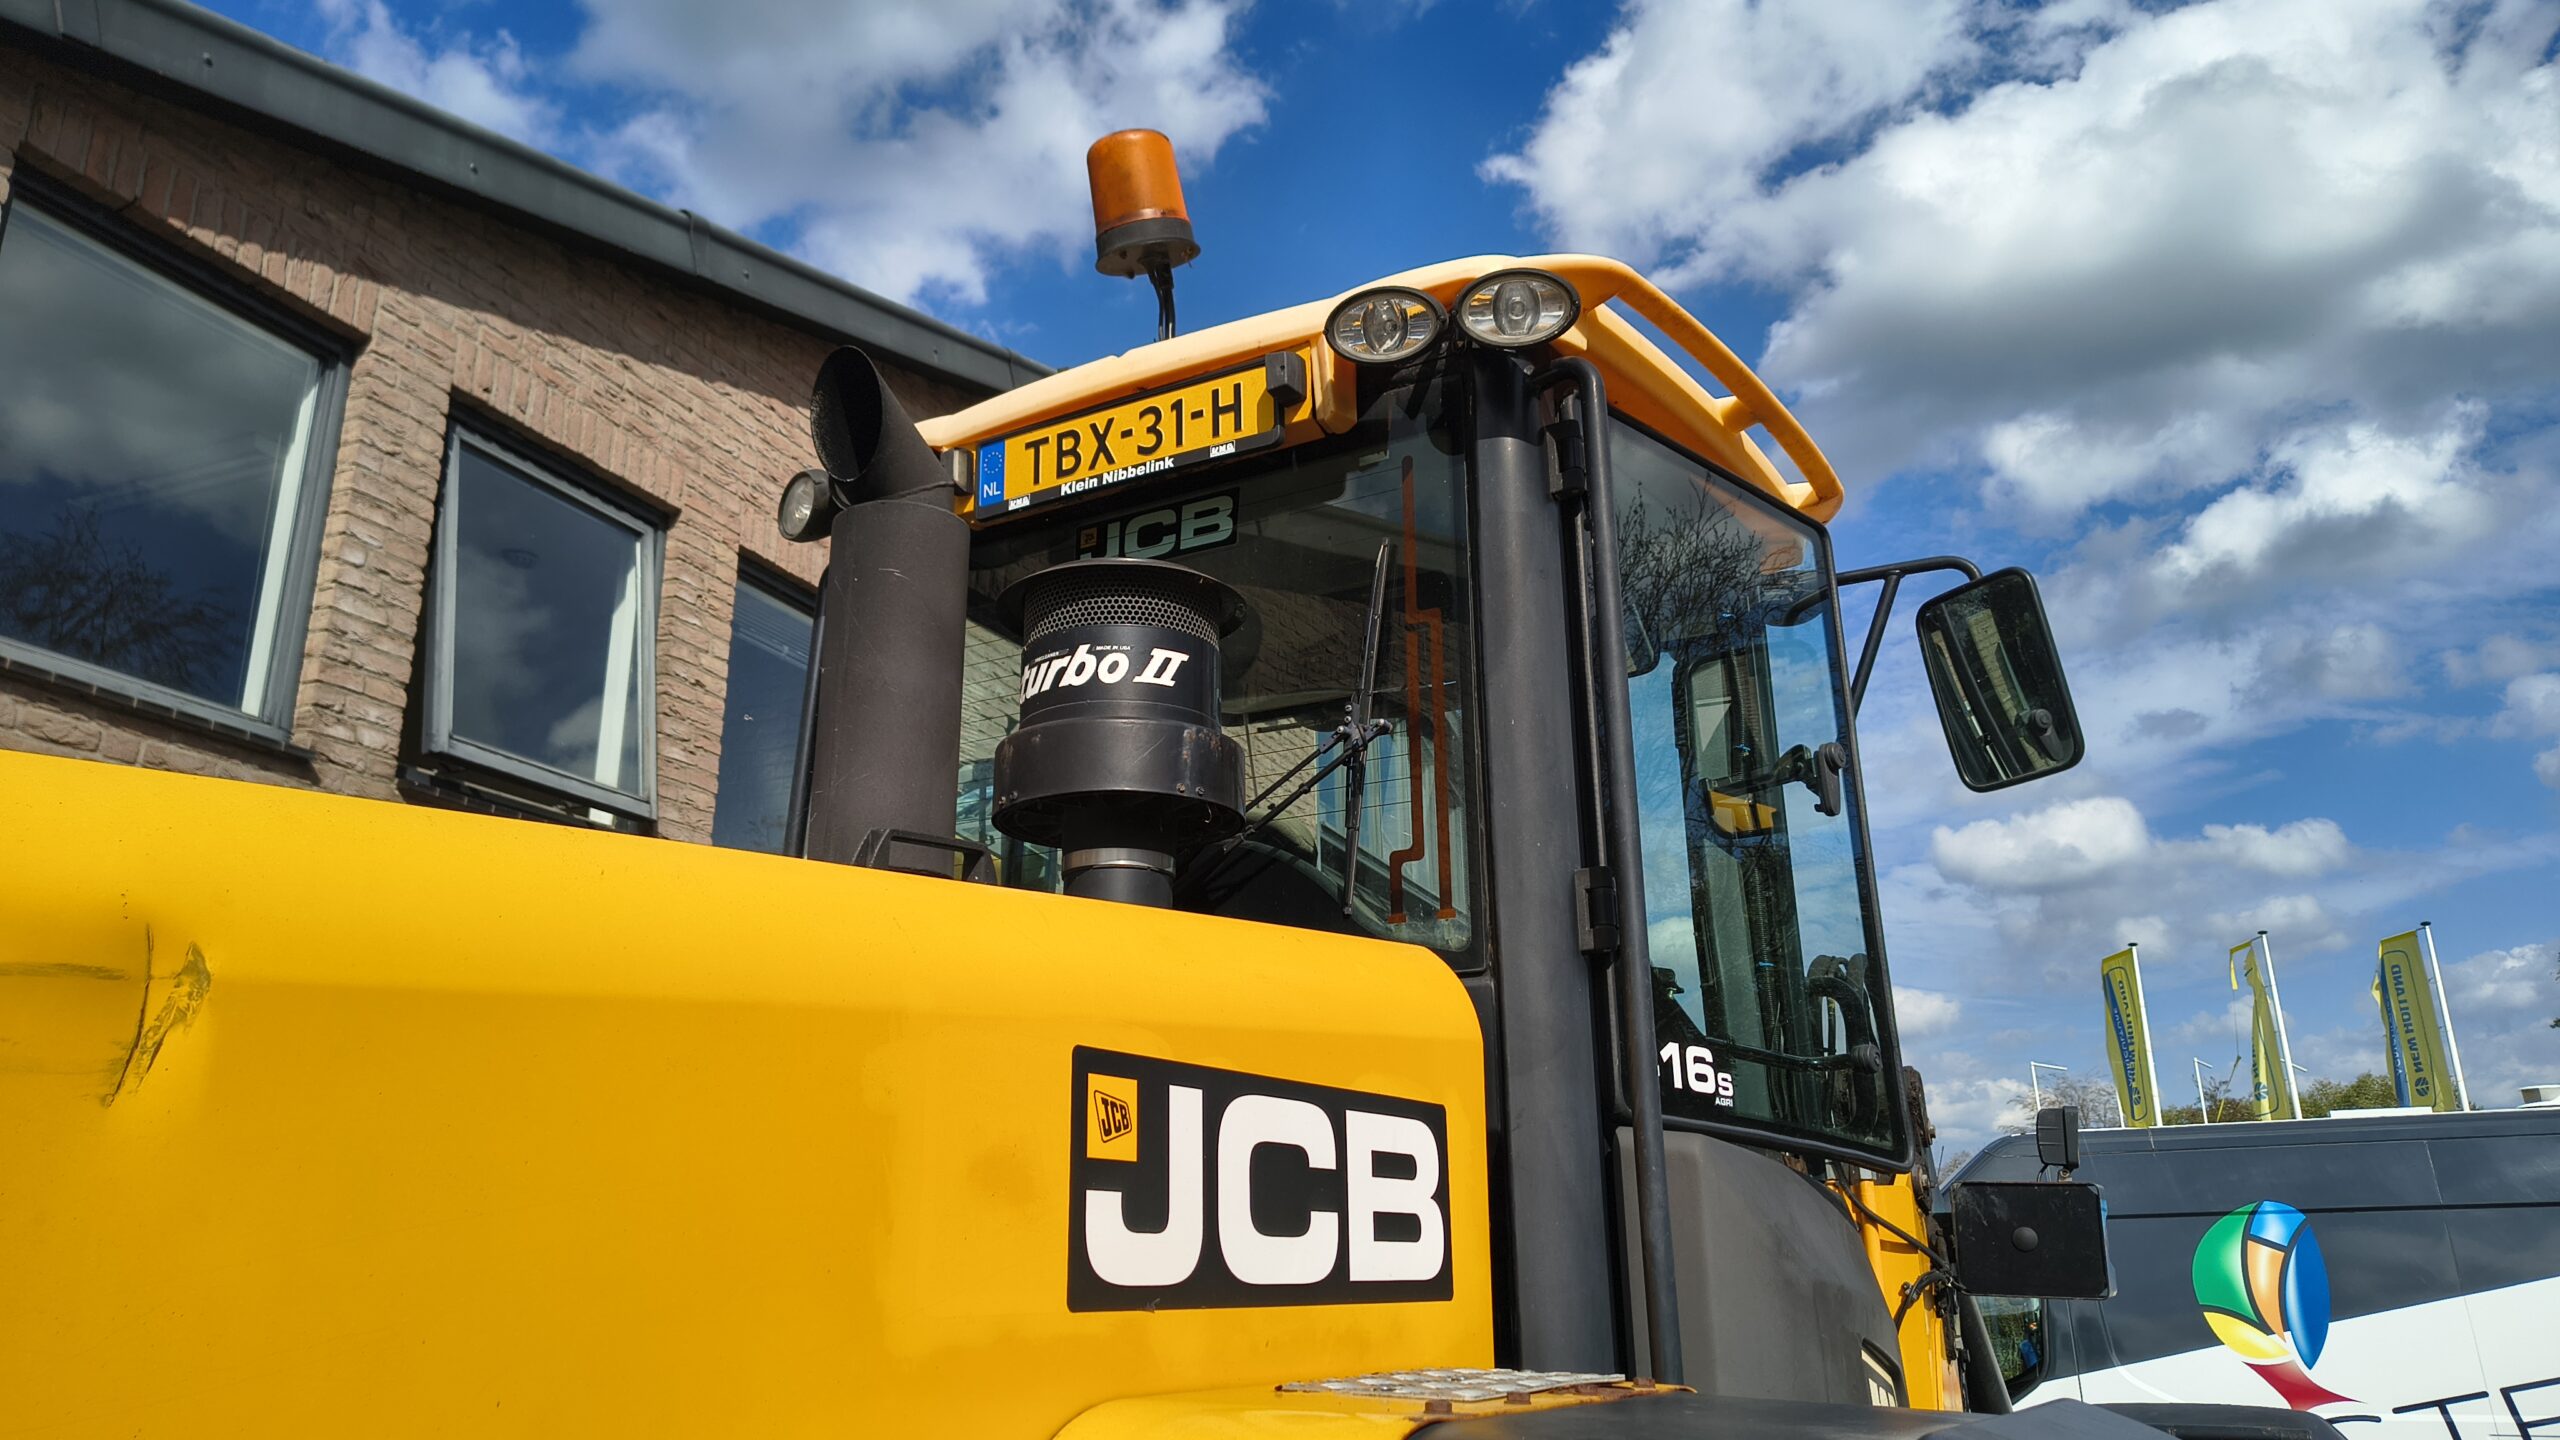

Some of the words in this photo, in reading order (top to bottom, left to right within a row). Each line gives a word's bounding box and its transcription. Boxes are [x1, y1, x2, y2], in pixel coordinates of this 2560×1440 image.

[1025, 382, 1242, 485] TBX-31-H
[983, 481, 1001, 498] NL
[1060, 477, 1098, 496] Klein
[1102, 456, 1175, 486] Nibbelink
[1079, 495, 1234, 560] JCB
[1132, 647, 1190, 687] II
[1101, 1097, 1130, 1137] JCB
[1085, 1083, 1445, 1287] JCB
